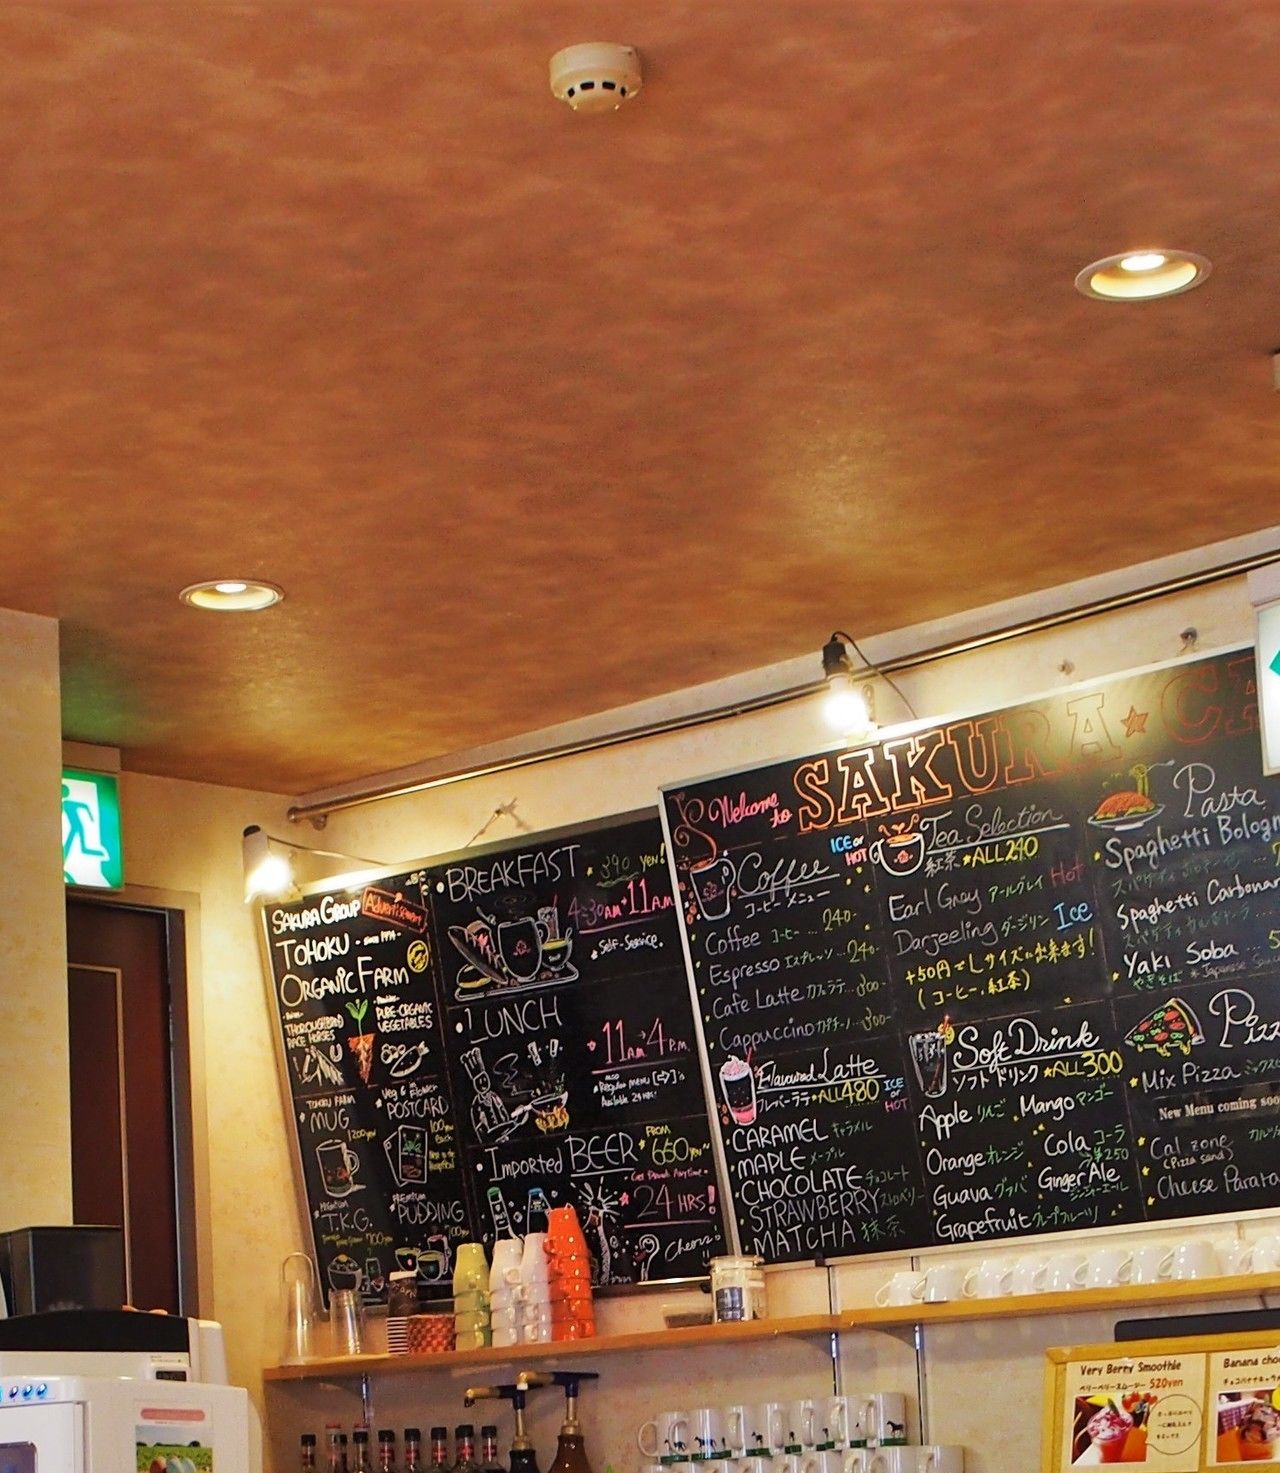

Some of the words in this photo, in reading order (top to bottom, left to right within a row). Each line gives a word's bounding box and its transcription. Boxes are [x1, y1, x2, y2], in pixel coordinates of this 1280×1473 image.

[794, 692, 1123, 833] SAKURA
[1173, 762, 1266, 819] Pasta
[708, 792, 779, 828] Welcome
[770, 809, 792, 828] to
[920, 810, 961, 851] Tea
[965, 803, 1064, 844] Selection
[830, 837, 853, 854] ICE
[844, 848, 868, 866] HOT
[1105, 826, 1211, 874] Spaghetti
[444, 844, 581, 902] BREAKFAST
[736, 852, 830, 902] Coffee
[272, 909, 321, 934] SAKURA
[888, 889, 933, 922] Earl
[1117, 891, 1200, 935] Spaghetti
[705, 924, 762, 956] Coffee
[893, 921, 999, 957] Darjeeling
[1054, 901, 1094, 931] Ice
[275, 933, 350, 970] TOHOKU
[1124, 950, 1171, 980] Yaki
[1186, 940, 1239, 965] Soba
[357, 956, 410, 993] FARM
[709, 957, 780, 990] Espresso
[464, 996, 563, 1043] LUNCH
[713, 997, 751, 1020] Cafe
[755, 987, 805, 1009] Latte
[719, 1017, 815, 1052] Cappuccino
[952, 1026, 1011, 1074] Soft
[1008, 1018, 1100, 1056] Drink
[818, 1047, 880, 1084] Latte
[1141, 1068, 1177, 1093] Mix
[1182, 1061, 1242, 1084] Pizza
[883, 1077, 904, 1091] ICE
[310, 1108, 350, 1133] MUG
[386, 1096, 449, 1120] POSTCARD
[883, 1098, 908, 1113] HOT
[919, 1101, 973, 1141] Apple
[1020, 1094, 1075, 1121] Mango
[1158, 1106, 1182, 1120] New
[1184, 1101, 1215, 1118] Menu
[1217, 1097, 1258, 1115] coming
[732, 1118, 829, 1152] CARAMEL
[1044, 1131, 1091, 1157] Cola
[564, 1131, 638, 1173] BEER
[737, 1147, 806, 1179] MAPLE
[927, 1148, 987, 1176] Orange
[741, 1165, 863, 1206] CHOCOLATE
[1038, 1166, 1088, 1193] Ginger
[1088, 1161, 1120, 1184] Ale
[1157, 1174, 1218, 1200] Cheese
[397, 1200, 465, 1225] PUDDING
[634, 1184, 674, 1219] 24
[749, 1188, 881, 1232] STRAWBERRY
[933, 1184, 993, 1210] Guava
[753, 1219, 856, 1259] MATCHA
[936, 1206, 1032, 1242] Grapefruit
[1081, 1365, 1102, 1376] Very
[1106, 1364, 1134, 1375] Berry
[1138, 1359, 1181, 1373] Smoothie
[1223, 1358, 1258, 1369] Banana
